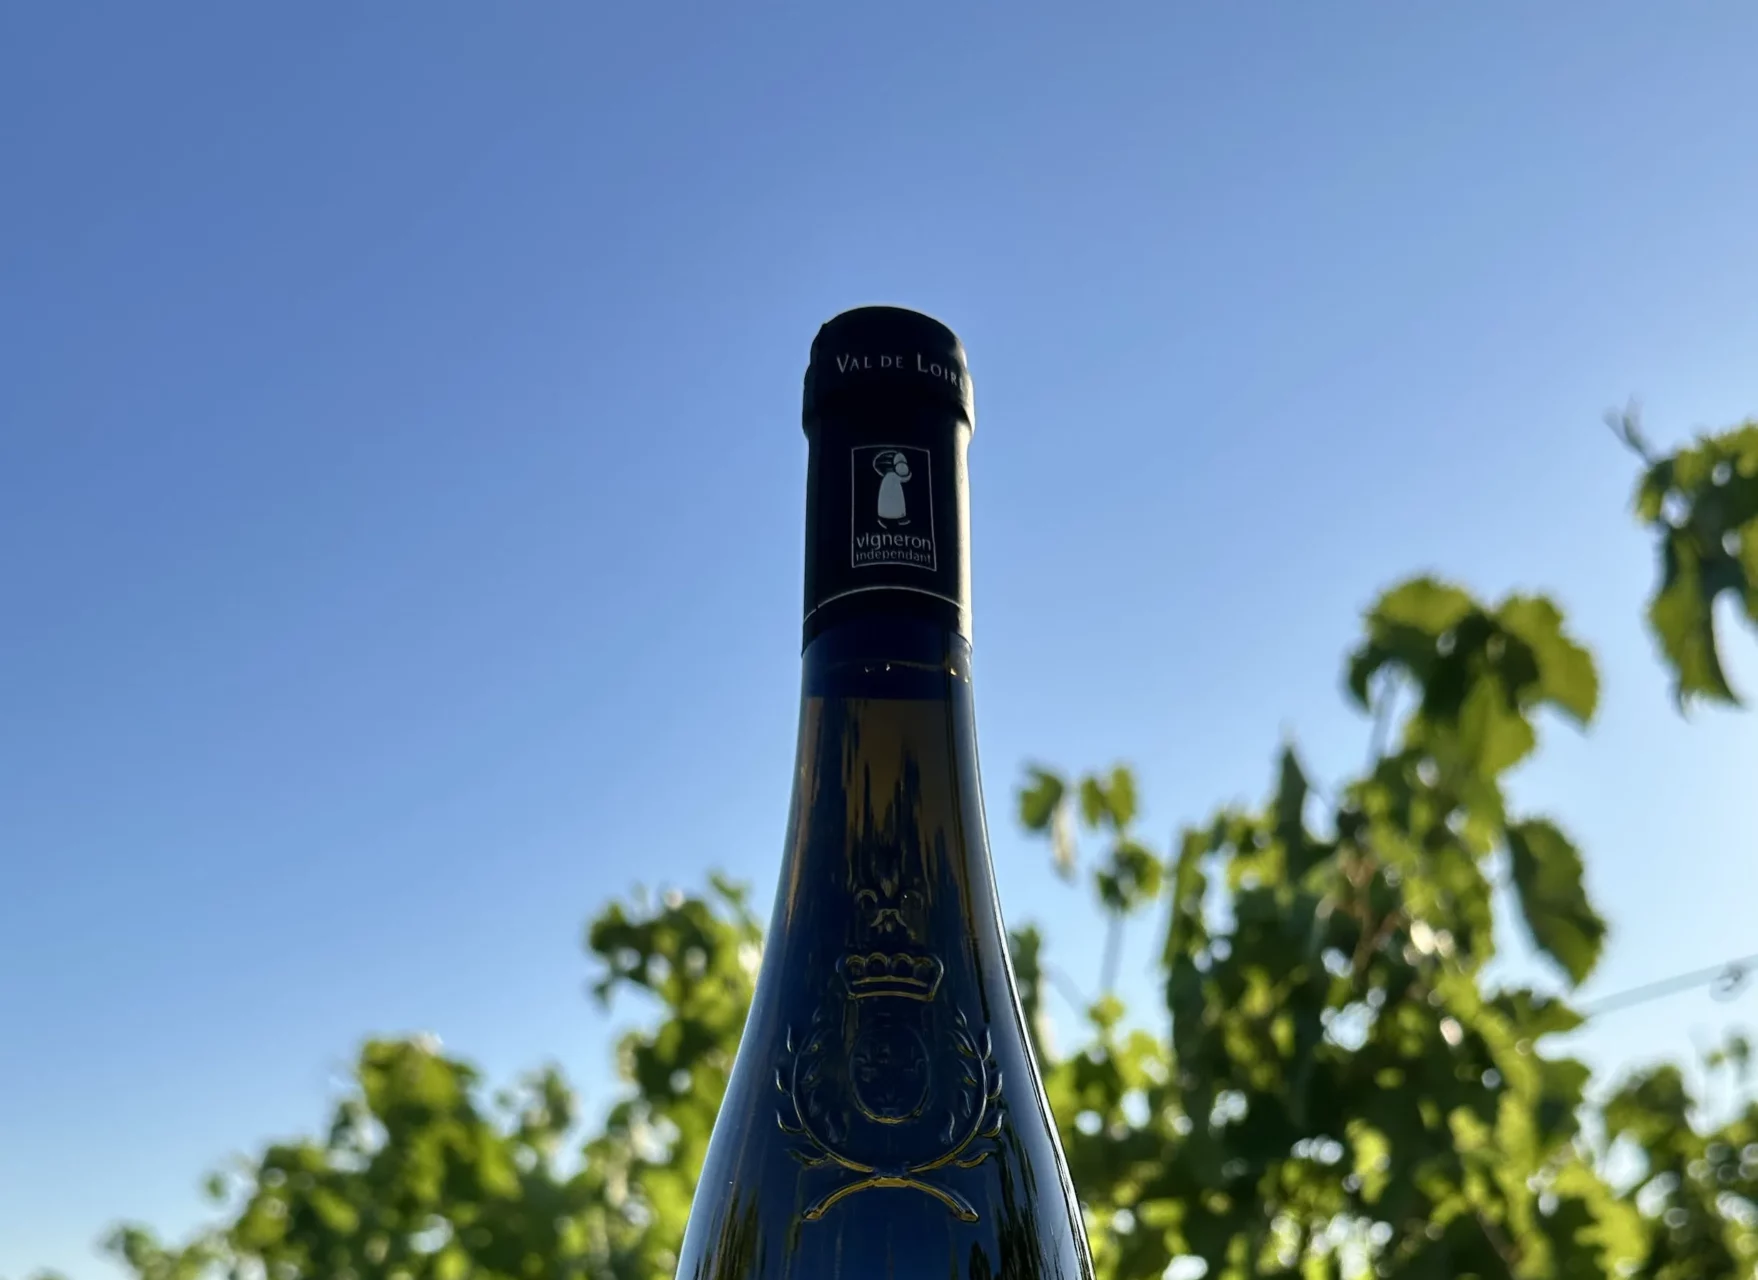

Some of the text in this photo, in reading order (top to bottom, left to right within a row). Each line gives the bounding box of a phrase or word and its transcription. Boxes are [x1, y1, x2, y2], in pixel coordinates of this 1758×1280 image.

[836, 353, 872, 374] VAL
[880, 355, 904, 369] DE
[856, 532, 931, 551] vigneron
